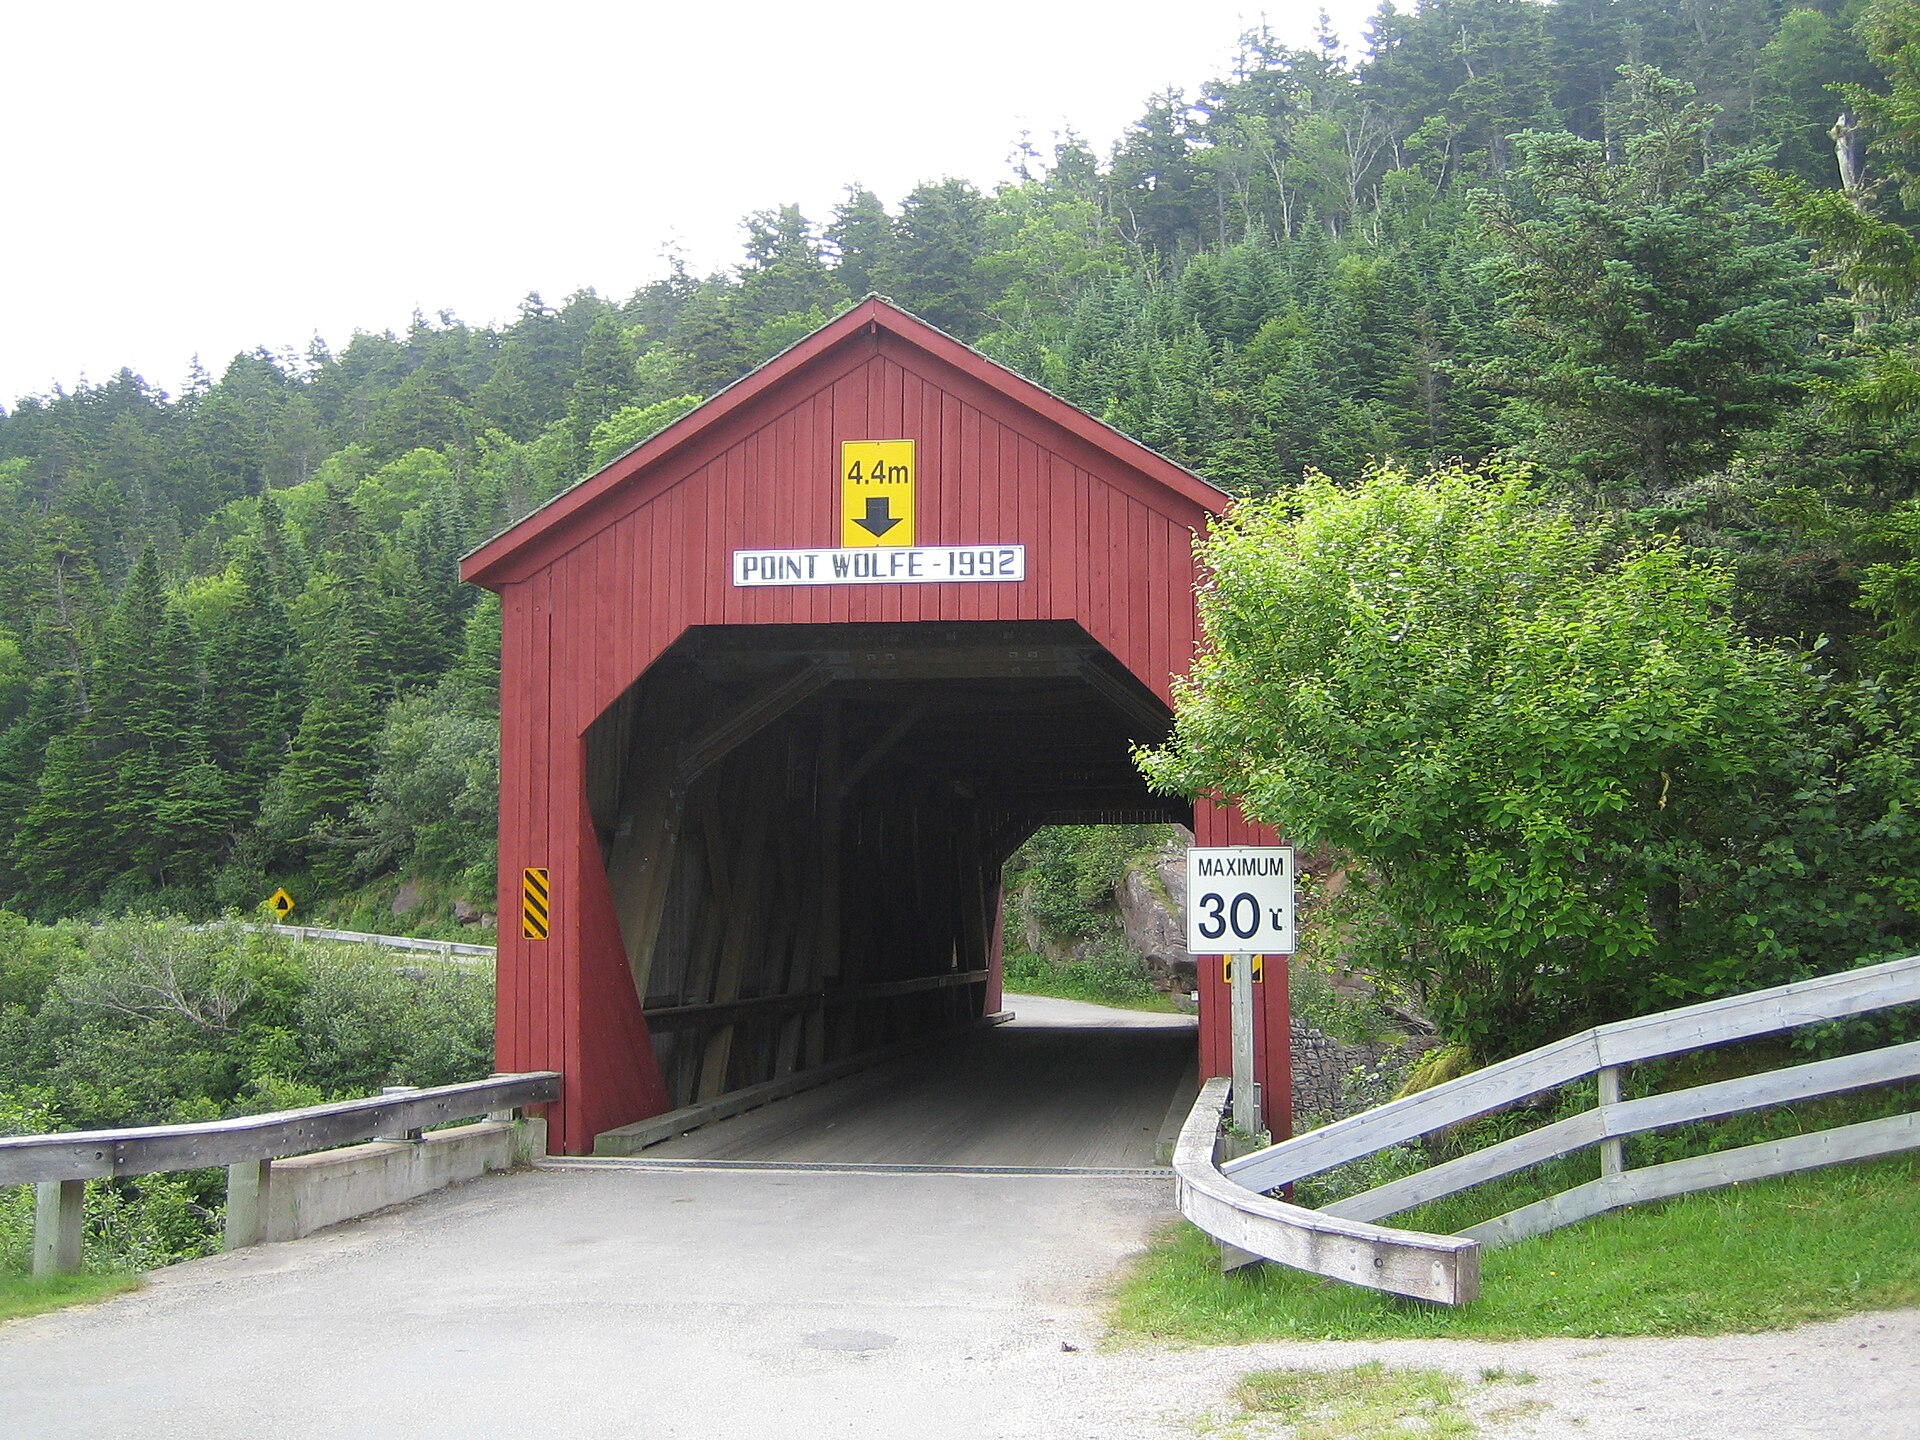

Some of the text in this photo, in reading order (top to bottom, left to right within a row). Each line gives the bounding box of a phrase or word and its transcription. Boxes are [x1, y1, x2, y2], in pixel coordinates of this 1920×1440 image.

[847, 460, 909, 485] 4.4m
[742, 555, 819, 580] POINT
[832, 552, 924, 578] WOLFE
[1198, 858, 1284, 876] MAXIMUM
[1198, 892, 1261, 939] 30
